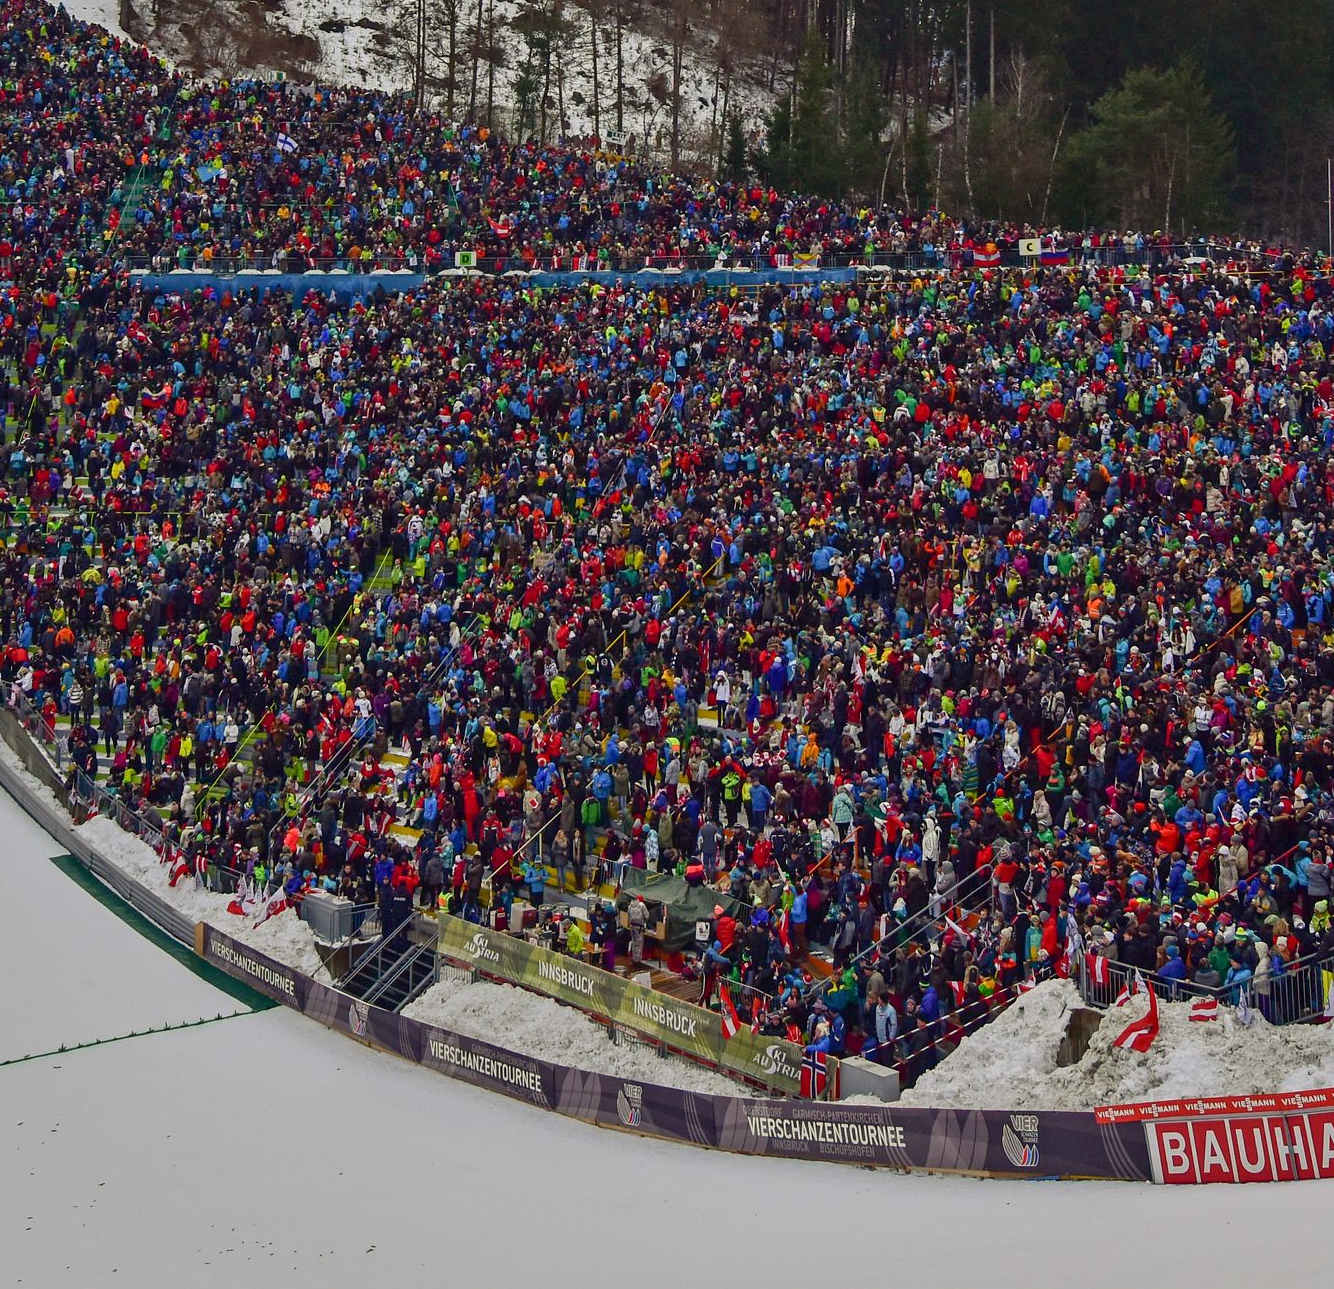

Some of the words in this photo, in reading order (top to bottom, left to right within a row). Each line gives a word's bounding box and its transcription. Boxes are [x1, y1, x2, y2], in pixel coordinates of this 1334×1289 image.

[1027, 243, 1033, 251] C
[464, 941, 500, 961] AUSTRIA
[210, 939, 295, 996] VIERSCHANZENTOURNEE
[538, 961, 594, 996] INNSBRUCK
[633, 998, 696, 1037] INNSBRUCK
[429, 1039, 542, 1093] VIERSCHANZENTOURNEE
[753, 1053, 801, 1081] AUSTRIA
[1185, 1100, 1227, 1114] VIESSMANN
[1232, 1097, 1275, 1111] VIESSMANN
[1281, 1094, 1326, 1108] VIESSMANN
[1097, 1108, 1134, 1121] VIESSMANN
[1139, 1104, 1179, 1117] VIESSMANN
[1010, 1115, 1039, 1131] VIER
[747, 1116, 906, 1147] VIERSCHANZENTOURNEE
[772, 1140, 809, 1152] INNSBRUCK
